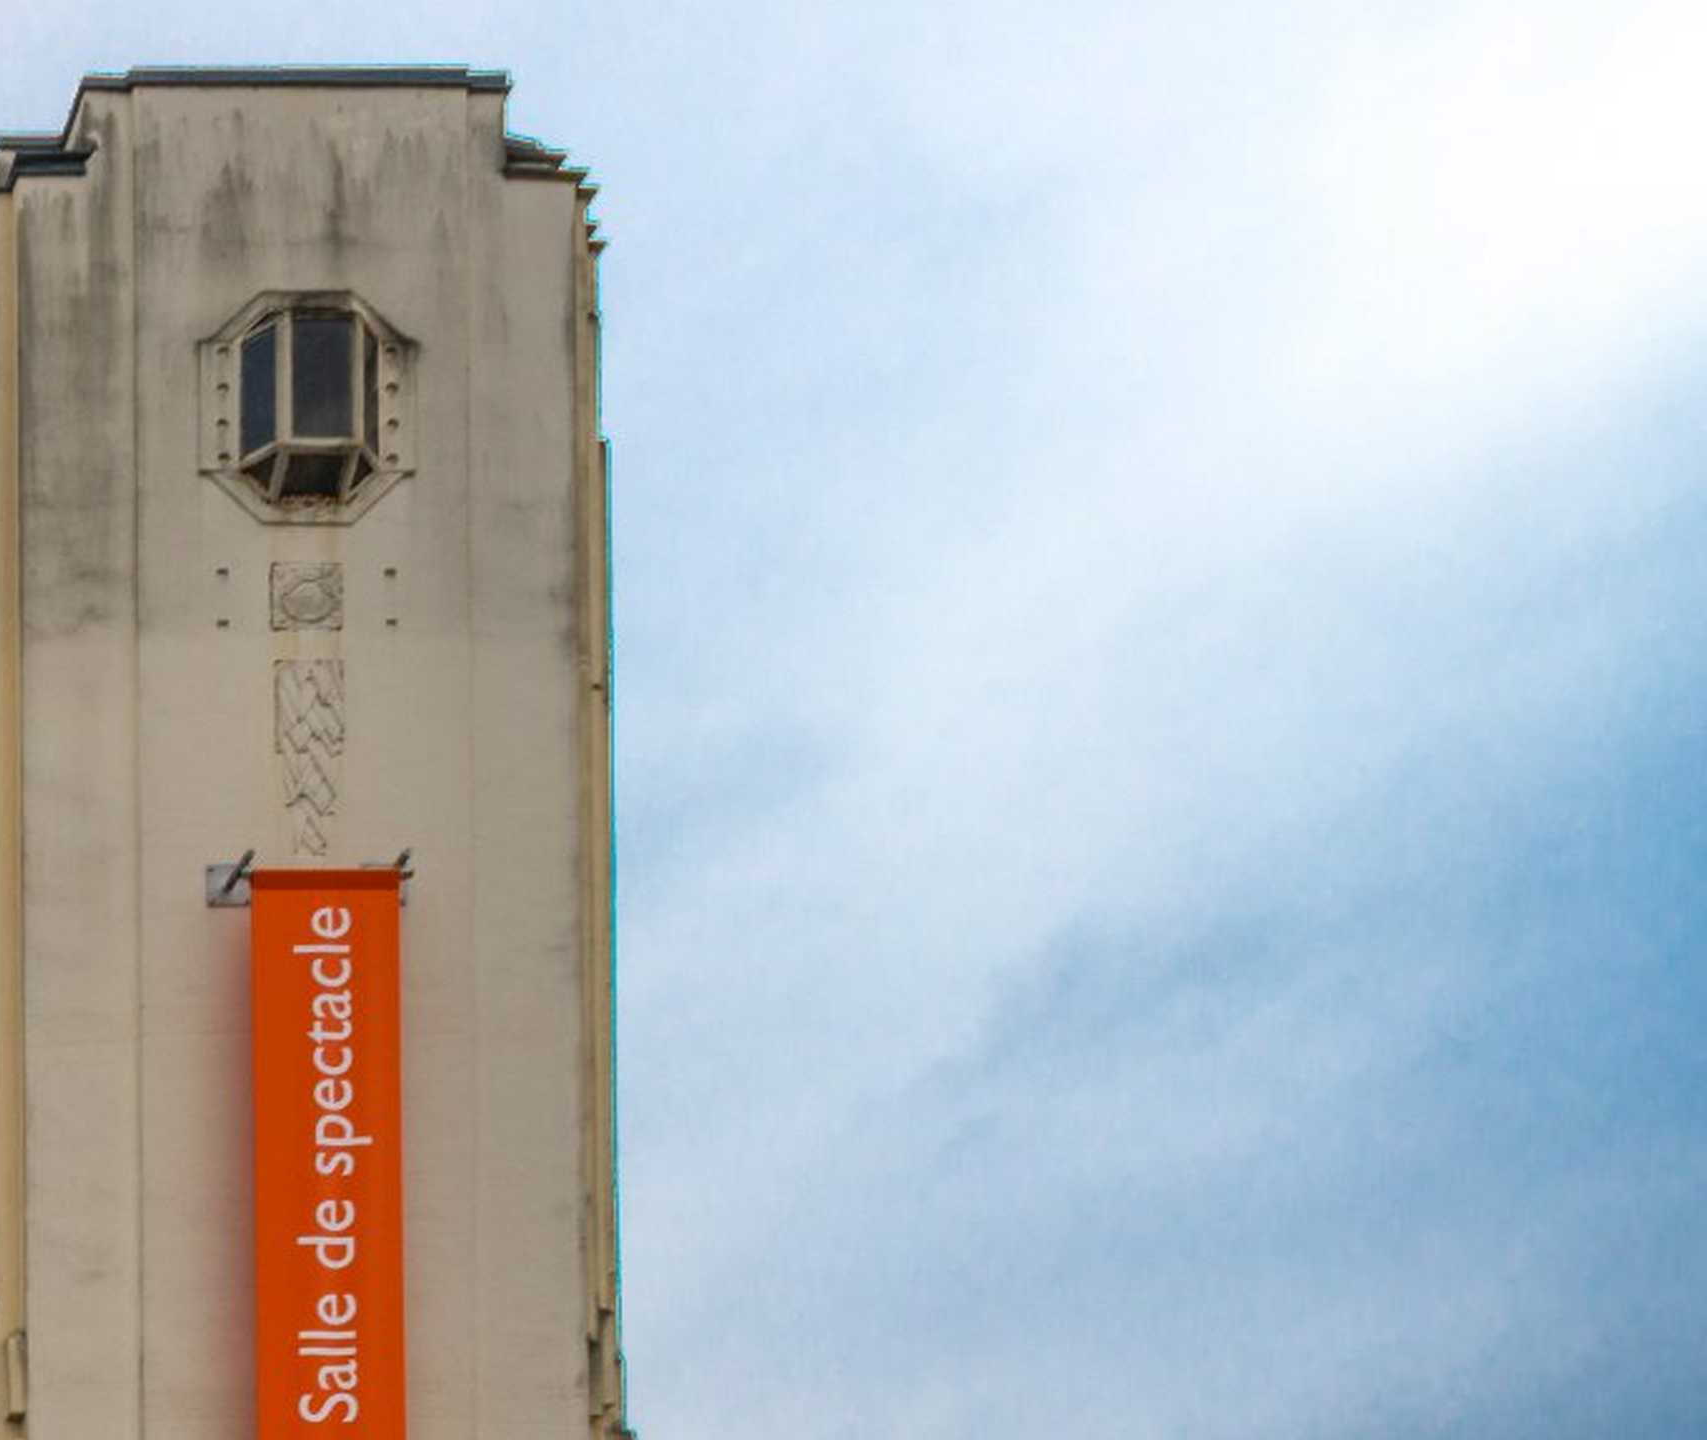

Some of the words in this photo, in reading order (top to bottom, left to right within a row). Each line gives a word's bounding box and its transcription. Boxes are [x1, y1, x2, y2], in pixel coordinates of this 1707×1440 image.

[293, 907, 373, 1176] spectacle
[297, 1199, 355, 1270] de
[298, 1293, 358, 1423] Salle
